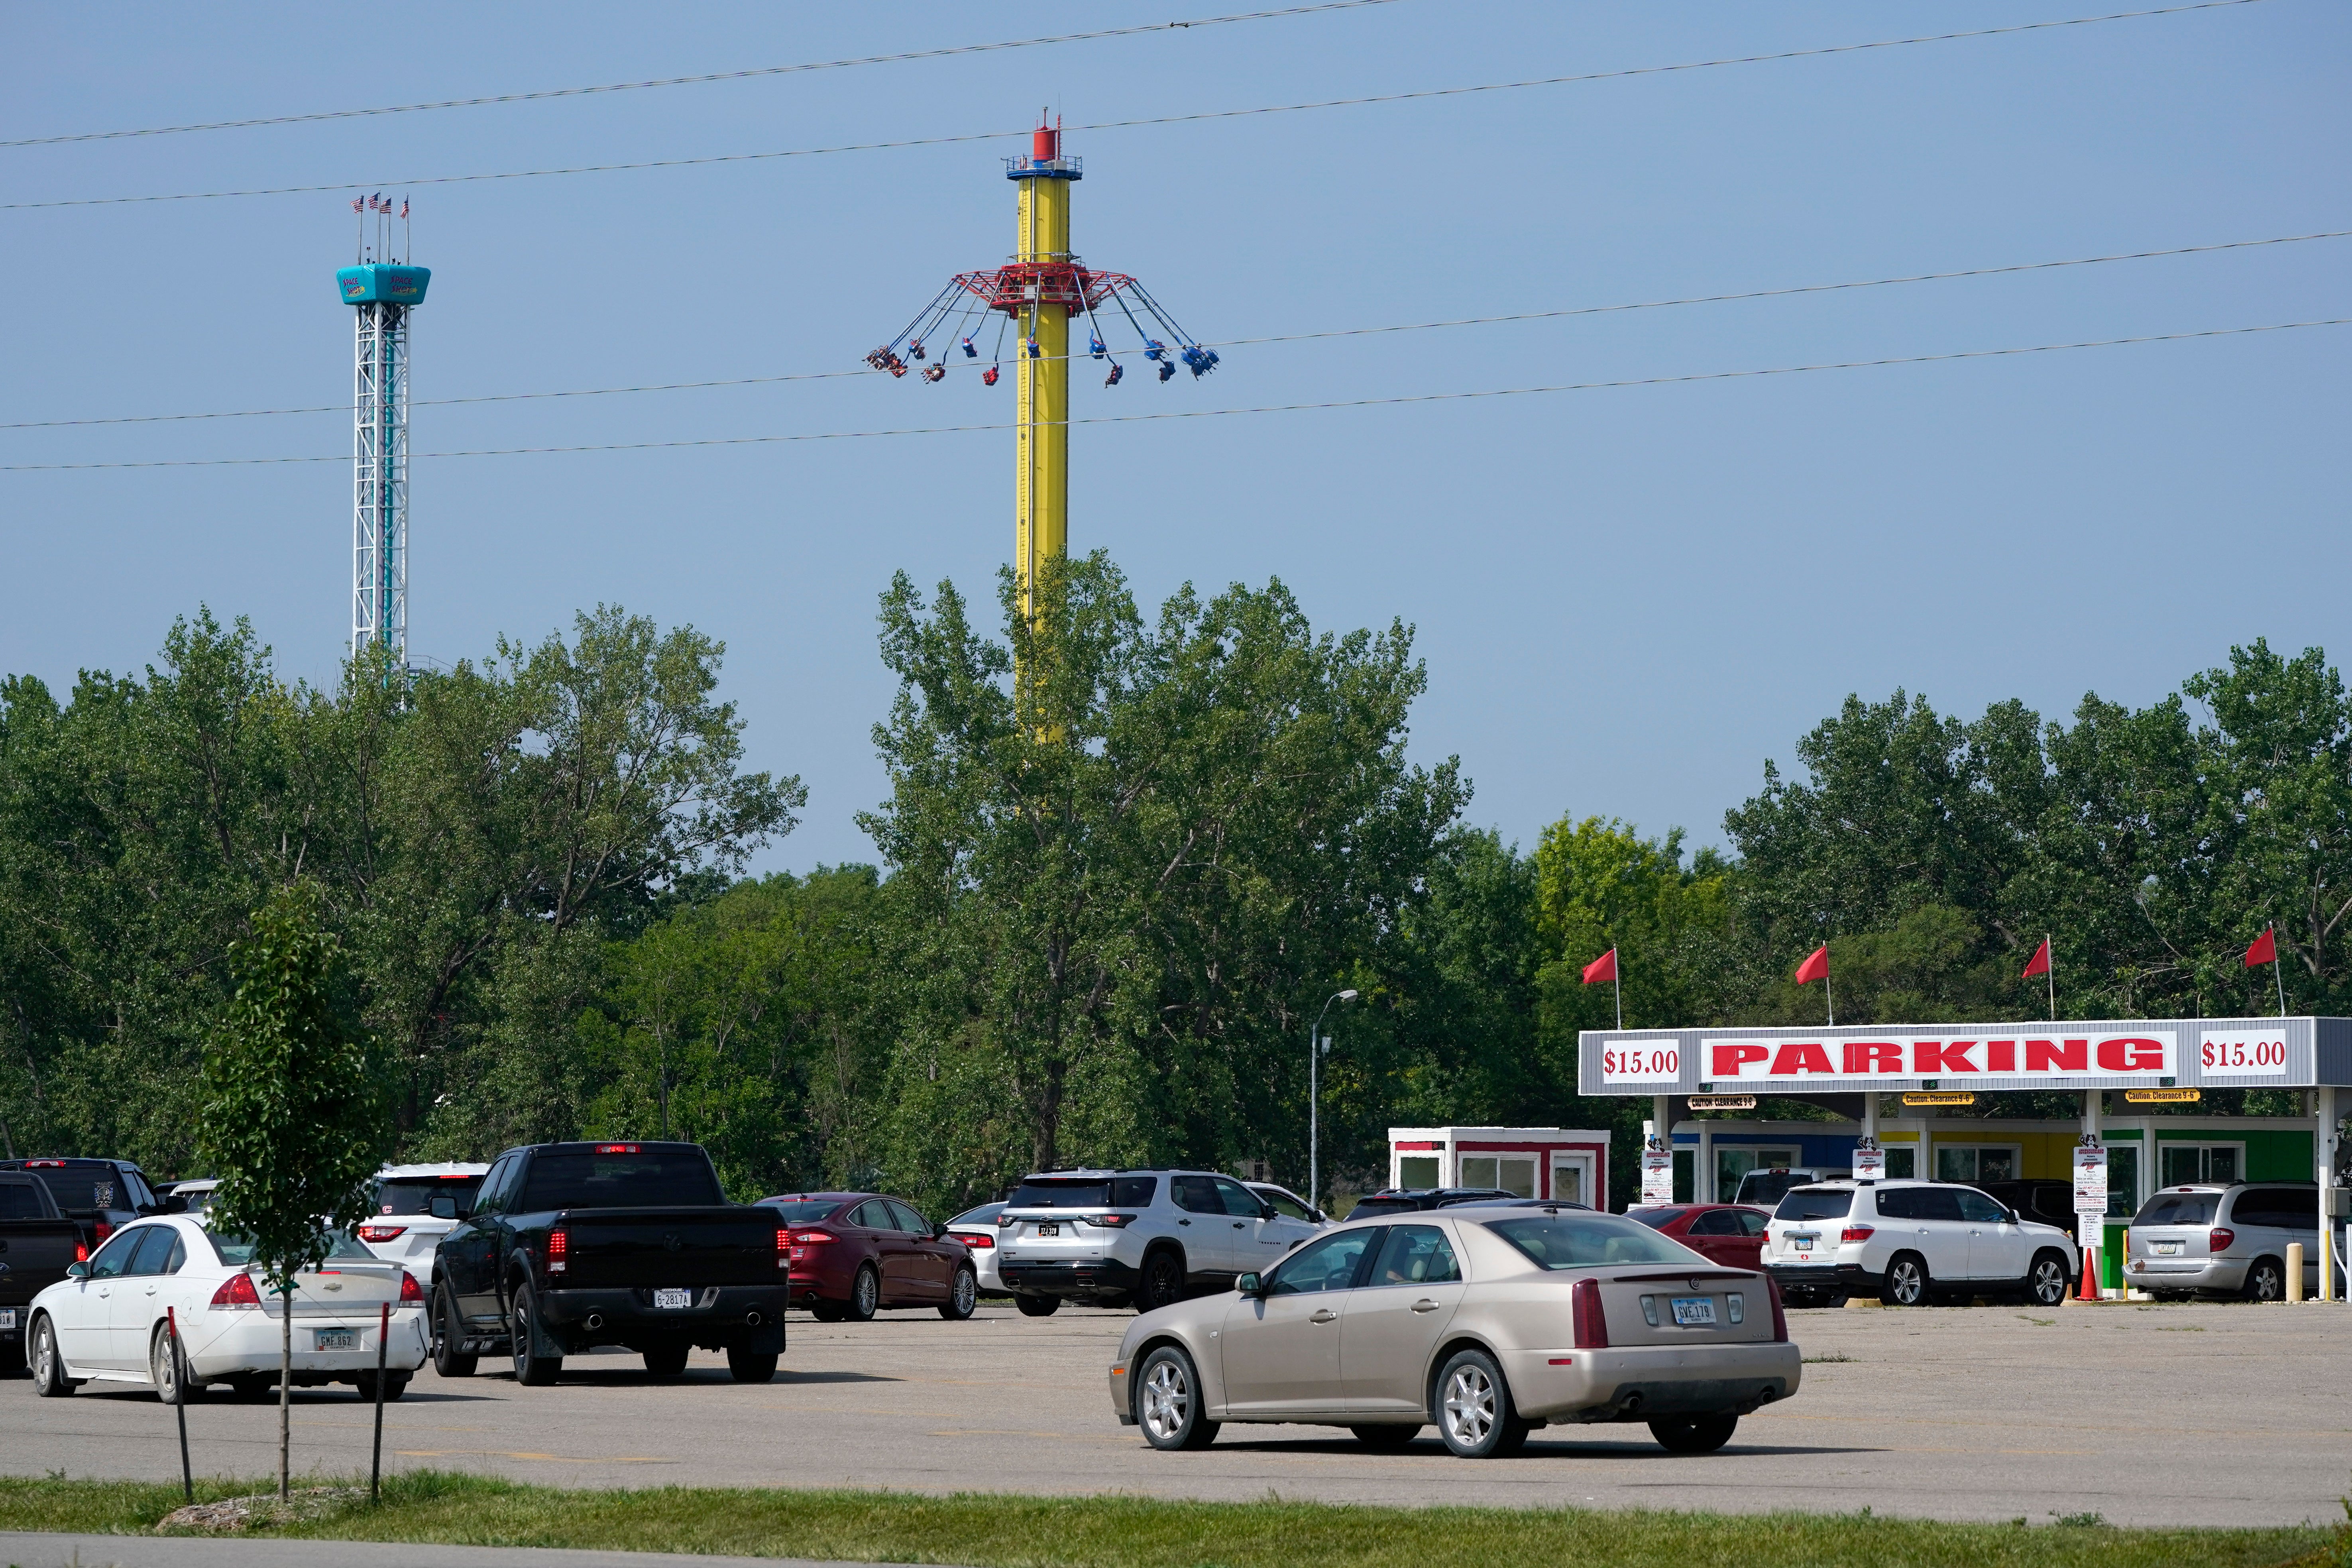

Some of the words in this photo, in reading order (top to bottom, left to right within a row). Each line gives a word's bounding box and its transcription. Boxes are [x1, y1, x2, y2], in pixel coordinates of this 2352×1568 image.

[343, 277, 359, 288] SPACE
[389, 275, 413, 285] SPACE
[347, 286, 360, 297] SHOT
[390, 284, 411, 294] SHOT
[1712, 1038, 2163, 1076] PARKING
[2202, 1039, 2285, 1069] $15.00
[1604, 1048, 1678, 1076] $15.00
[1692, 1098, 1713, 1107] CAUTION:
[1715, 1097, 1743, 1106] CLEARANCE
[382, 1205, 392, 1214] C
[658, 1295, 687, 1304] 6-2817A
[1678, 1307, 1693, 1318] GVE
[1695, 1306, 1709, 1318] 179
[321, 1336, 335, 1346] GMF
[338, 1336, 351, 1346] 862
